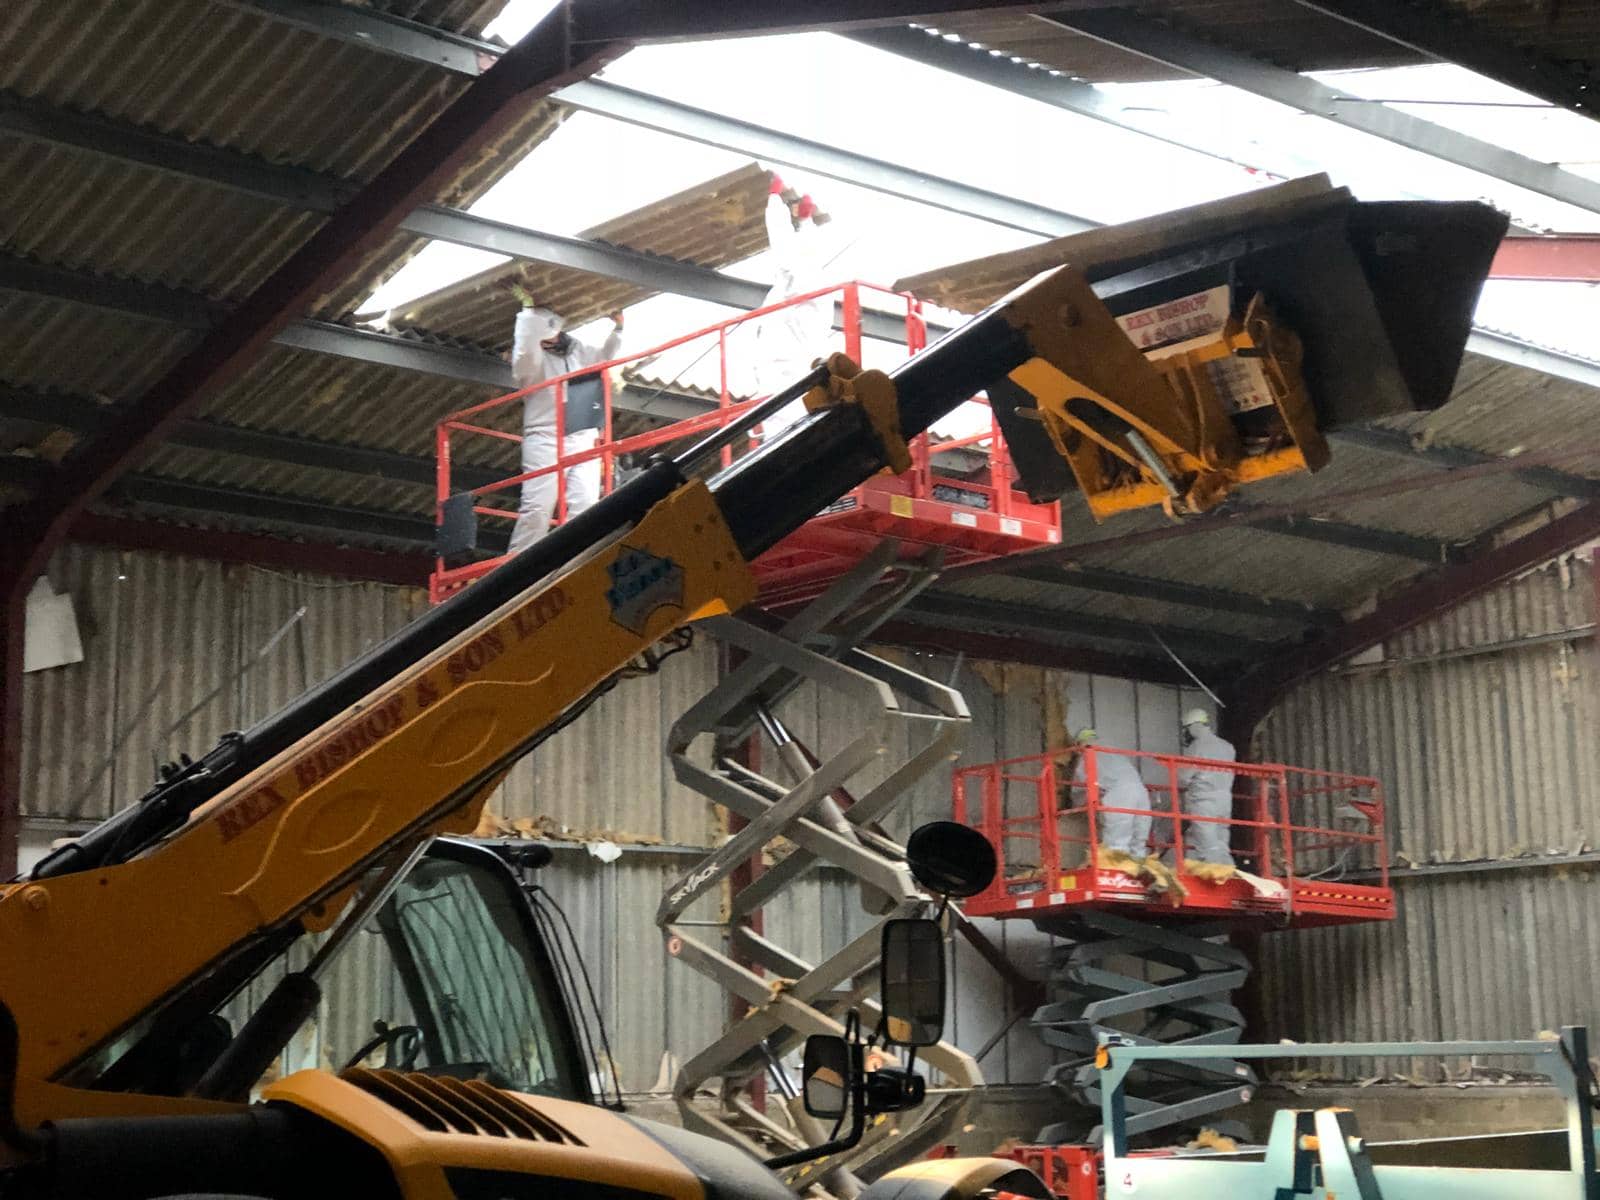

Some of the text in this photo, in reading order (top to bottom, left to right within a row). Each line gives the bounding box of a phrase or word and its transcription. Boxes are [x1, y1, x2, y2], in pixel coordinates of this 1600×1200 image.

[215, 785, 287, 844] REX
[294, 692, 406, 790] BISHOP
[416, 676, 439, 708] &
[446, 626, 504, 686] SON
[670, 862, 720, 905] SKYJACK
